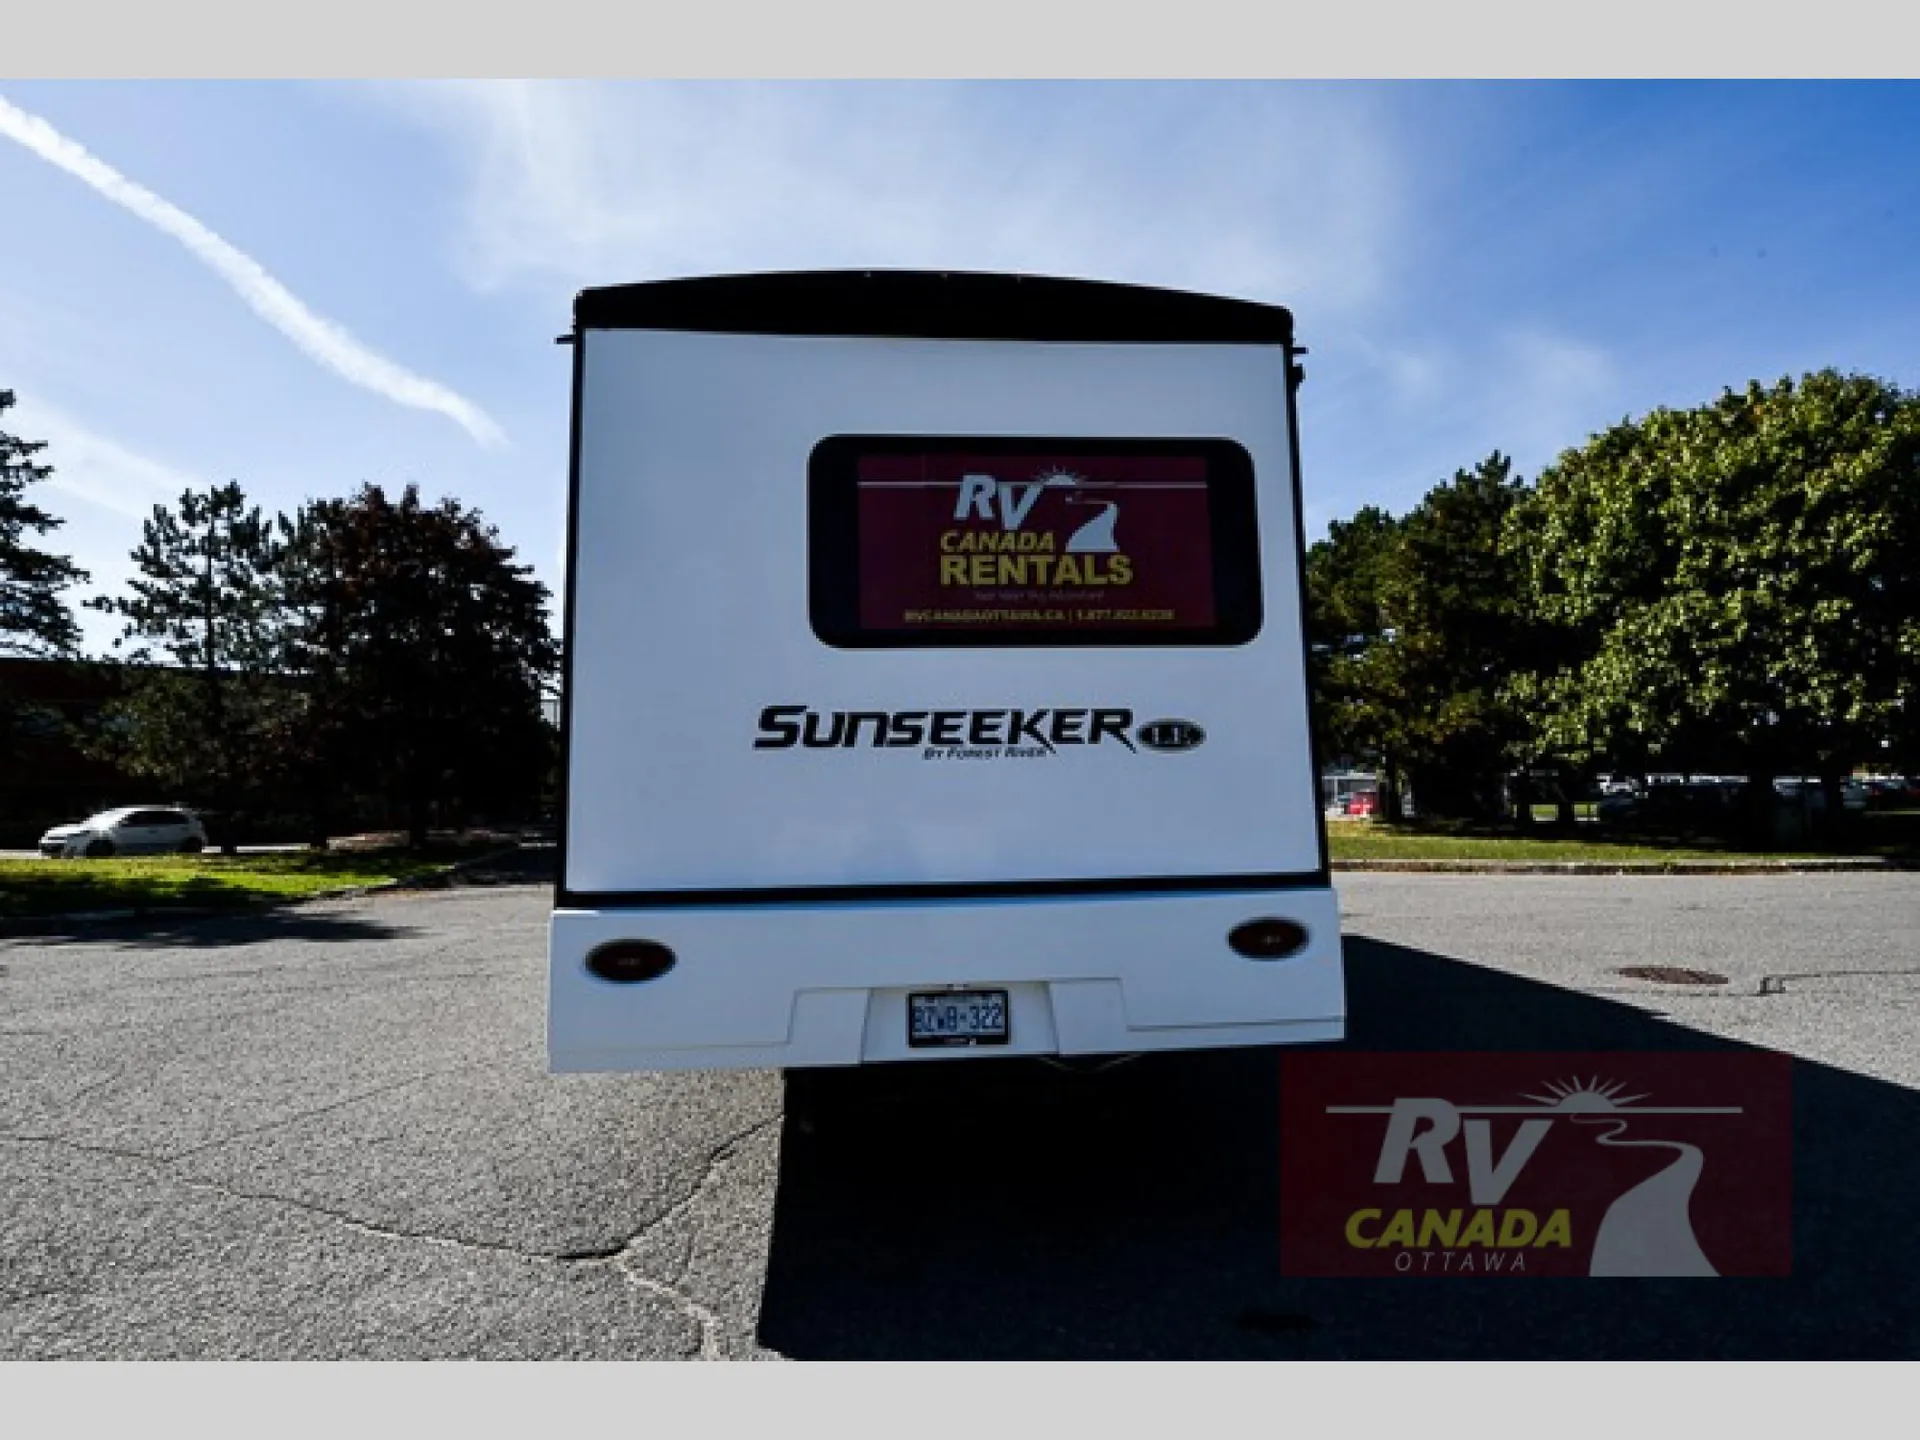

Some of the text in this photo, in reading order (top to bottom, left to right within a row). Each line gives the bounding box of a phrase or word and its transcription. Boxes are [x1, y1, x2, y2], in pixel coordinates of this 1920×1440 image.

[953, 474, 1045, 530] RV
[940, 531, 1056, 552] CANADA
[940, 554, 1134, 585] RENTALS
[753, 705, 1137, 753] SUNSEEKER
